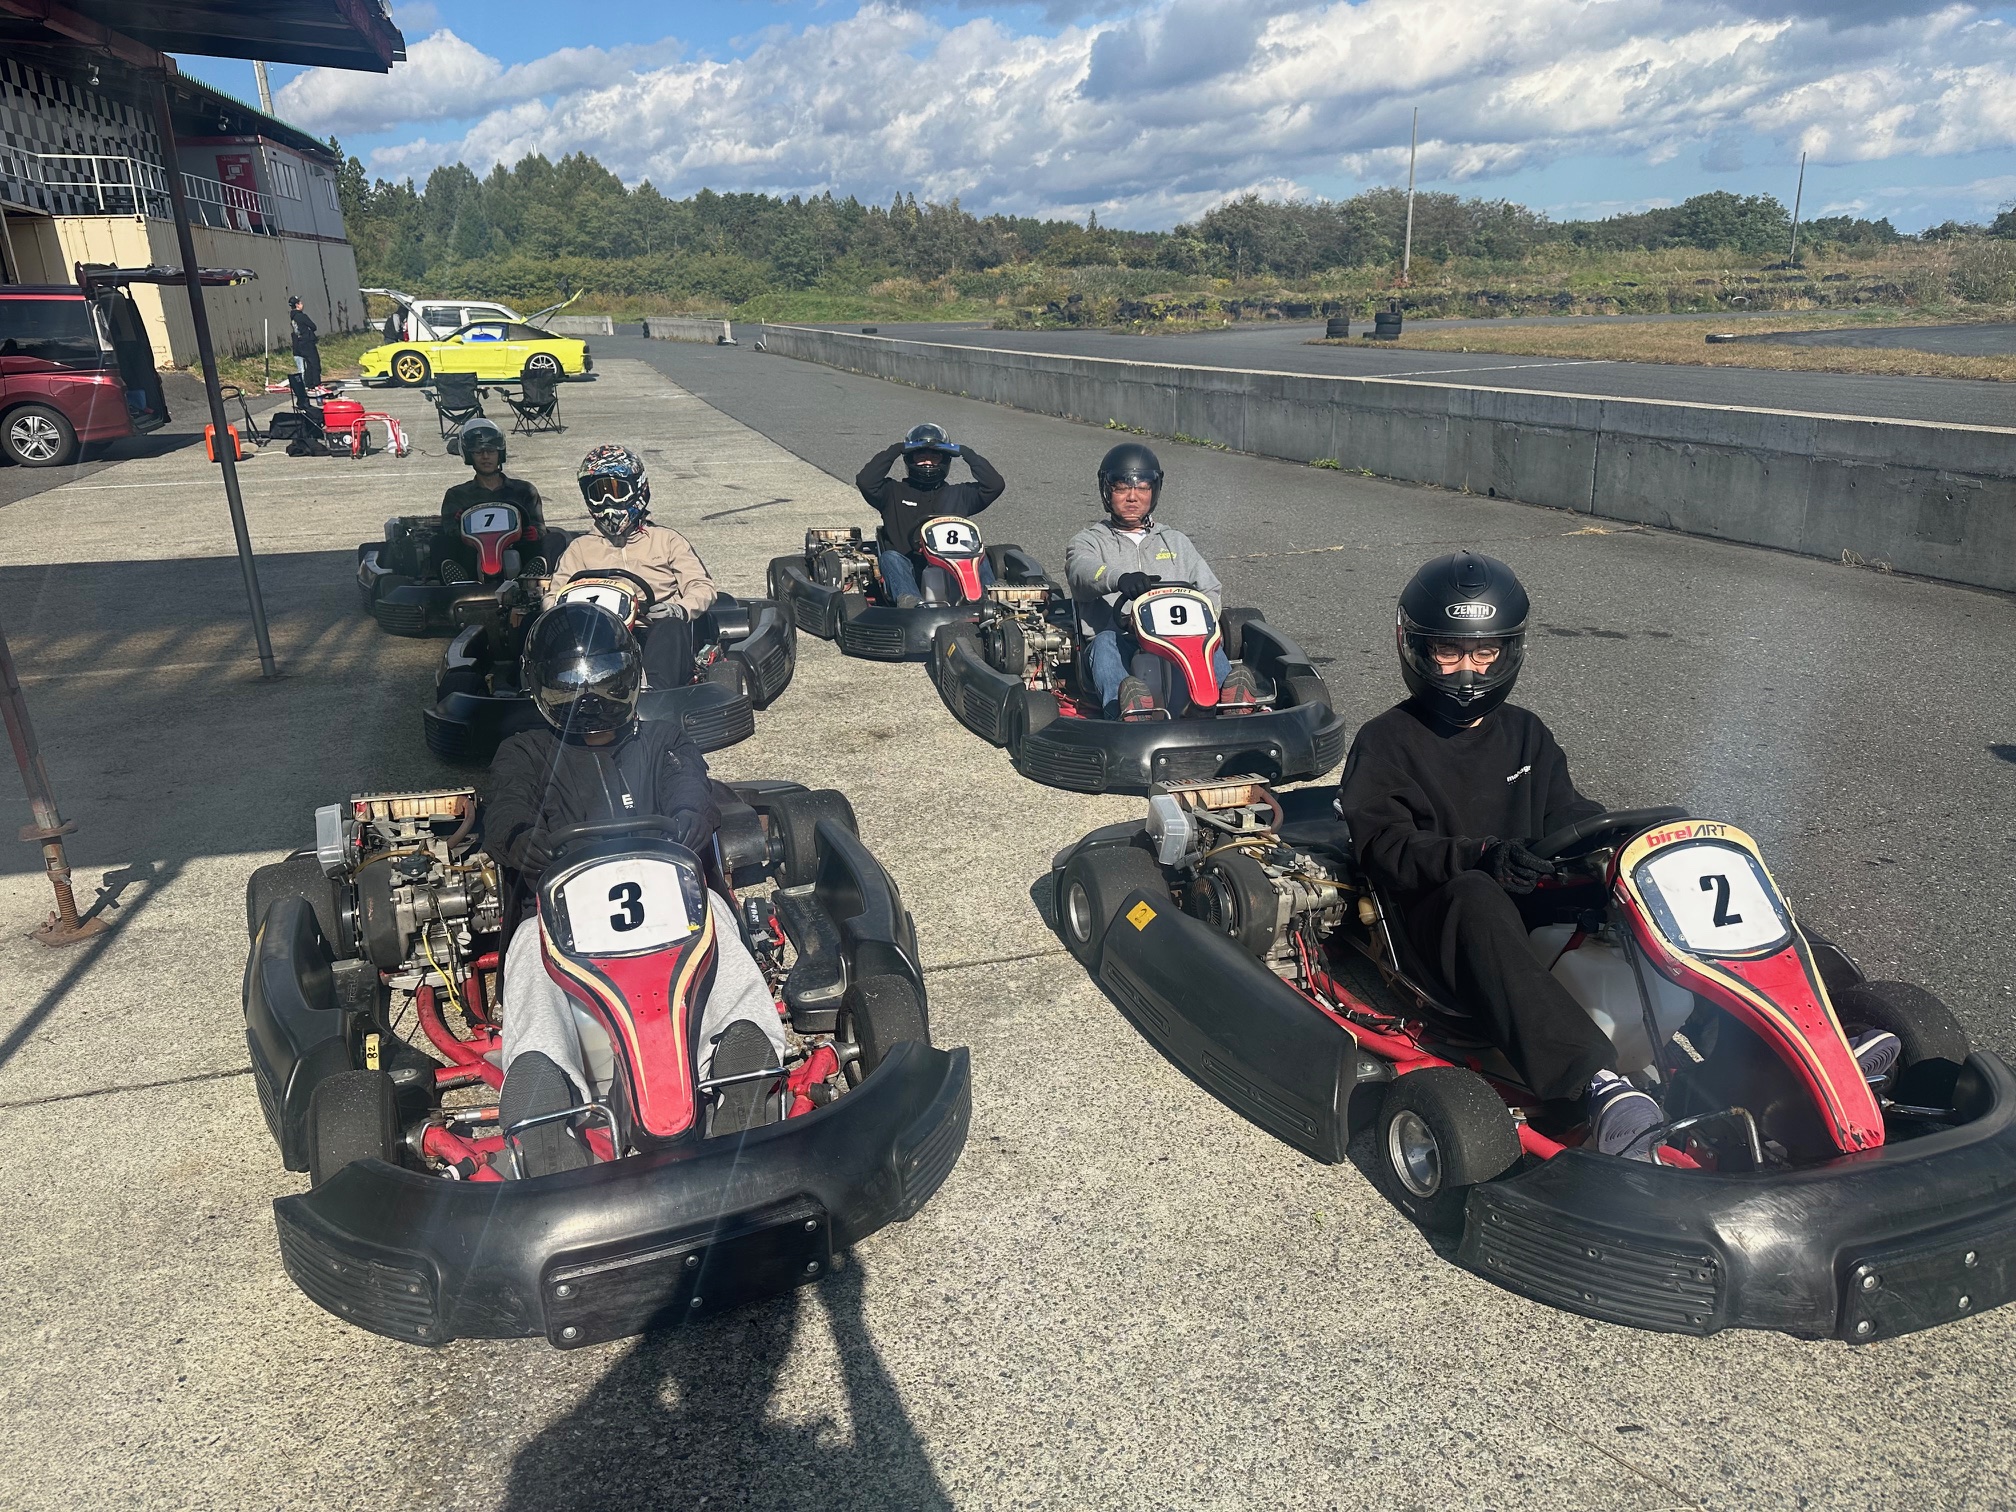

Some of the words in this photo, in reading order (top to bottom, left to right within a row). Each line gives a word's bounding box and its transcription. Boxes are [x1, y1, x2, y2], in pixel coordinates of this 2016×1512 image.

[484, 513, 495, 528] 7
[946, 530, 958, 545] 8
[1169, 605, 1188, 625] 9
[1452, 604, 1490, 615] ZENITH
[608, 881, 645, 933] 3
[1699, 874, 1743, 928] 2
